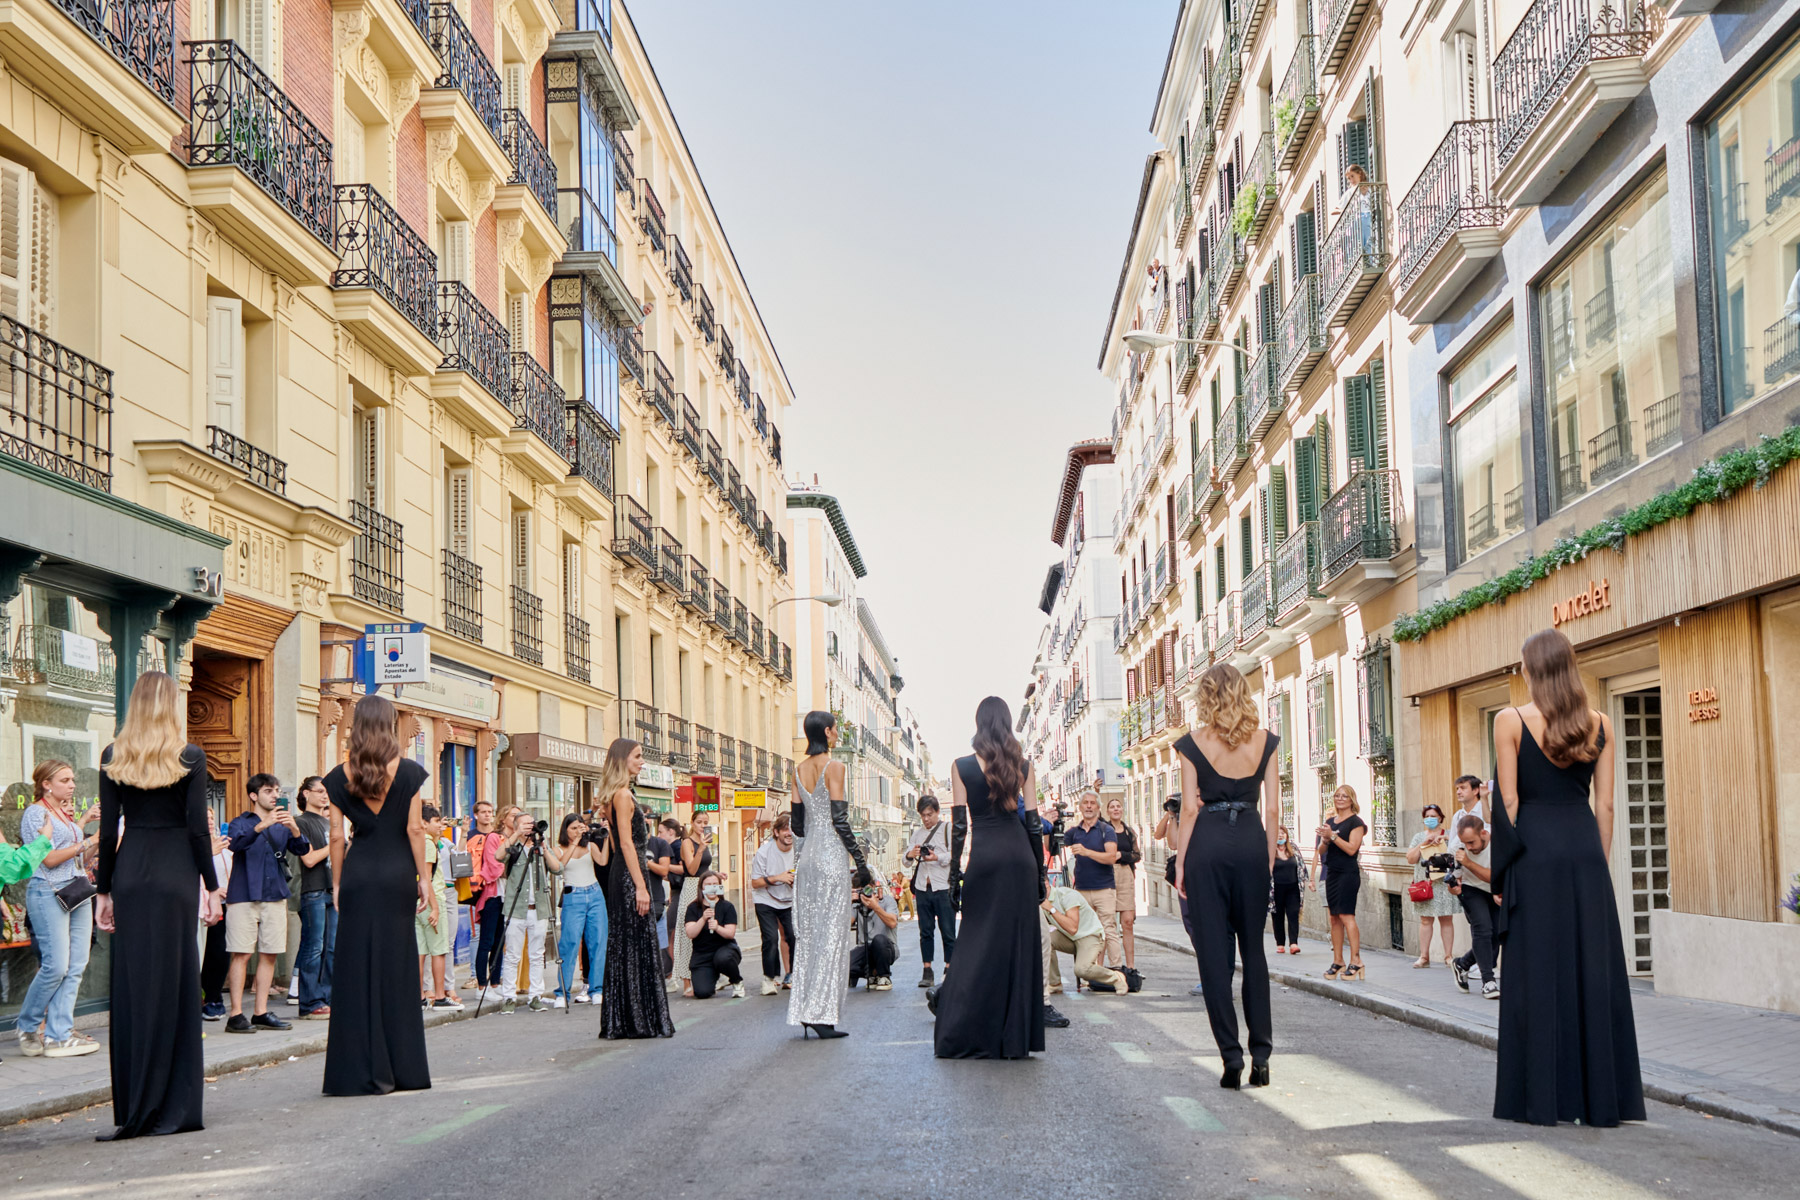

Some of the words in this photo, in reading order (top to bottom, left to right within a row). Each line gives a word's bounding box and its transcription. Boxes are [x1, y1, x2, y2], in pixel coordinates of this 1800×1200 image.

[193, 566, 223, 597] 30
[1553, 577, 1611, 628] poncelet
[1688, 686, 1718, 704] TIENDA
[1688, 706, 1719, 722] QUESOS
[546, 739, 589, 763] FERRETERIA
[592, 750, 608, 765] ARG
